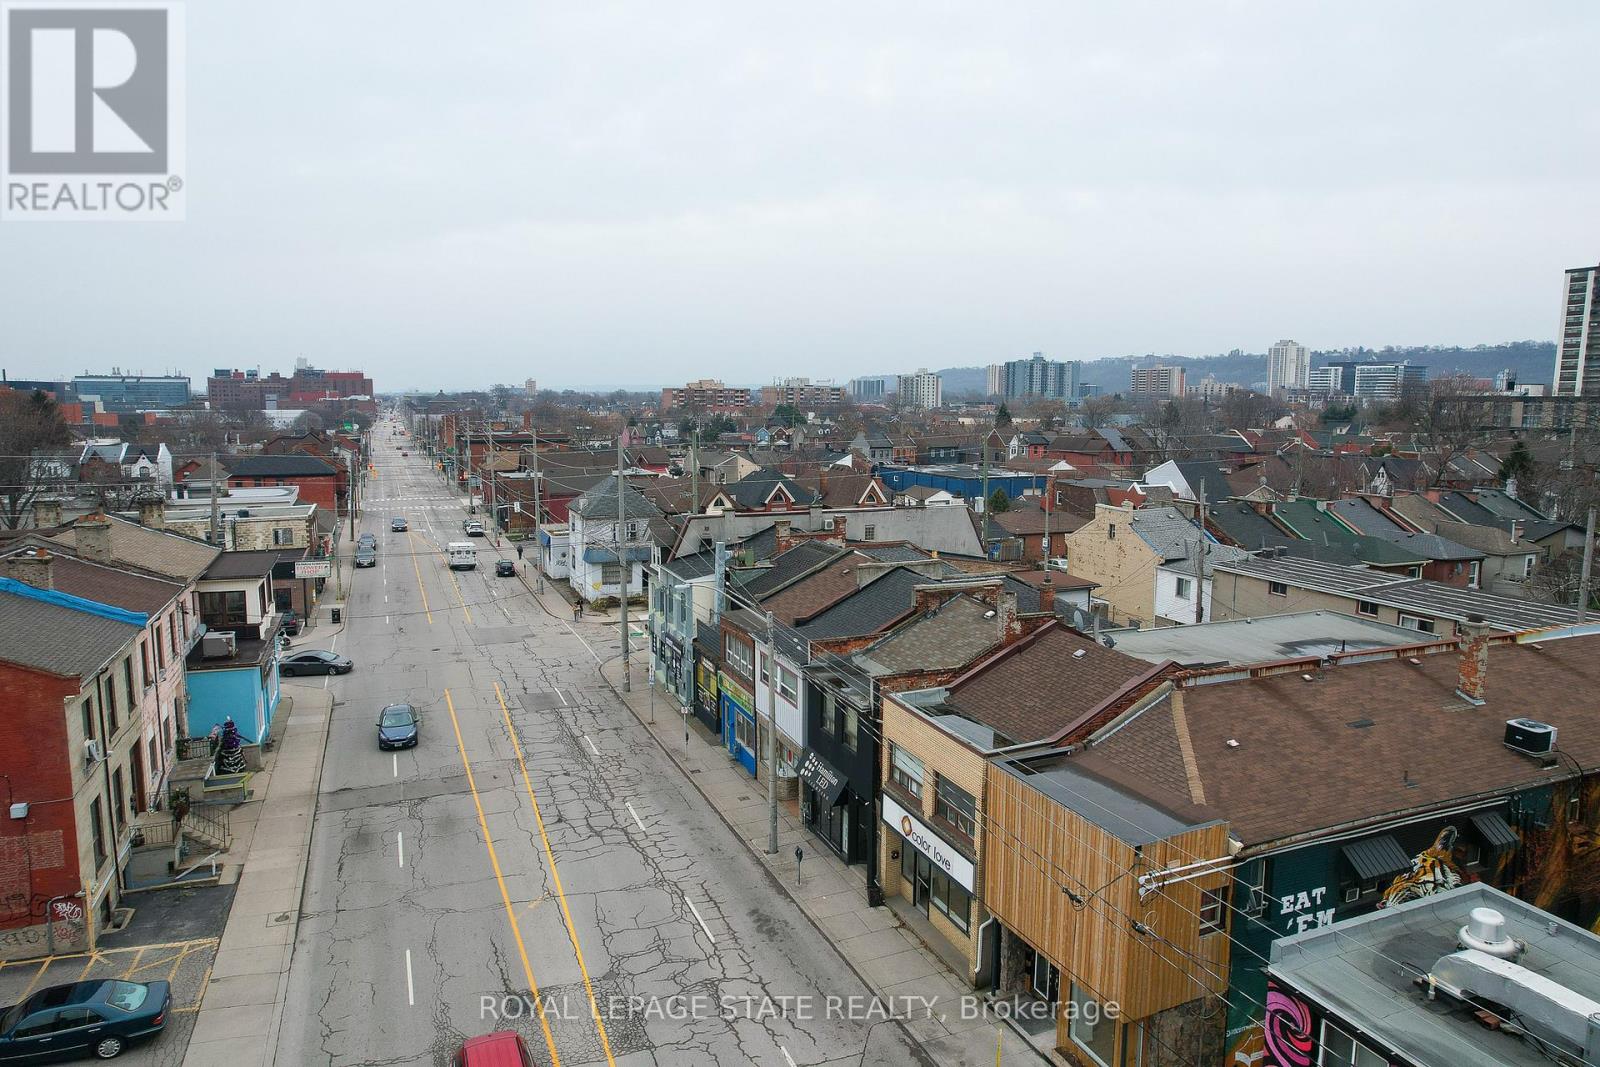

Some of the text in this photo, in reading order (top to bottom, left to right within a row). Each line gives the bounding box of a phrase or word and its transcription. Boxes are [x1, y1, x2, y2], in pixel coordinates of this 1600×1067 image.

[815, 774, 829, 790] LED
[816, 761, 839, 787] Hamilton
[911, 831, 951, 871] color love
[1280, 886, 1327, 915] EAT
